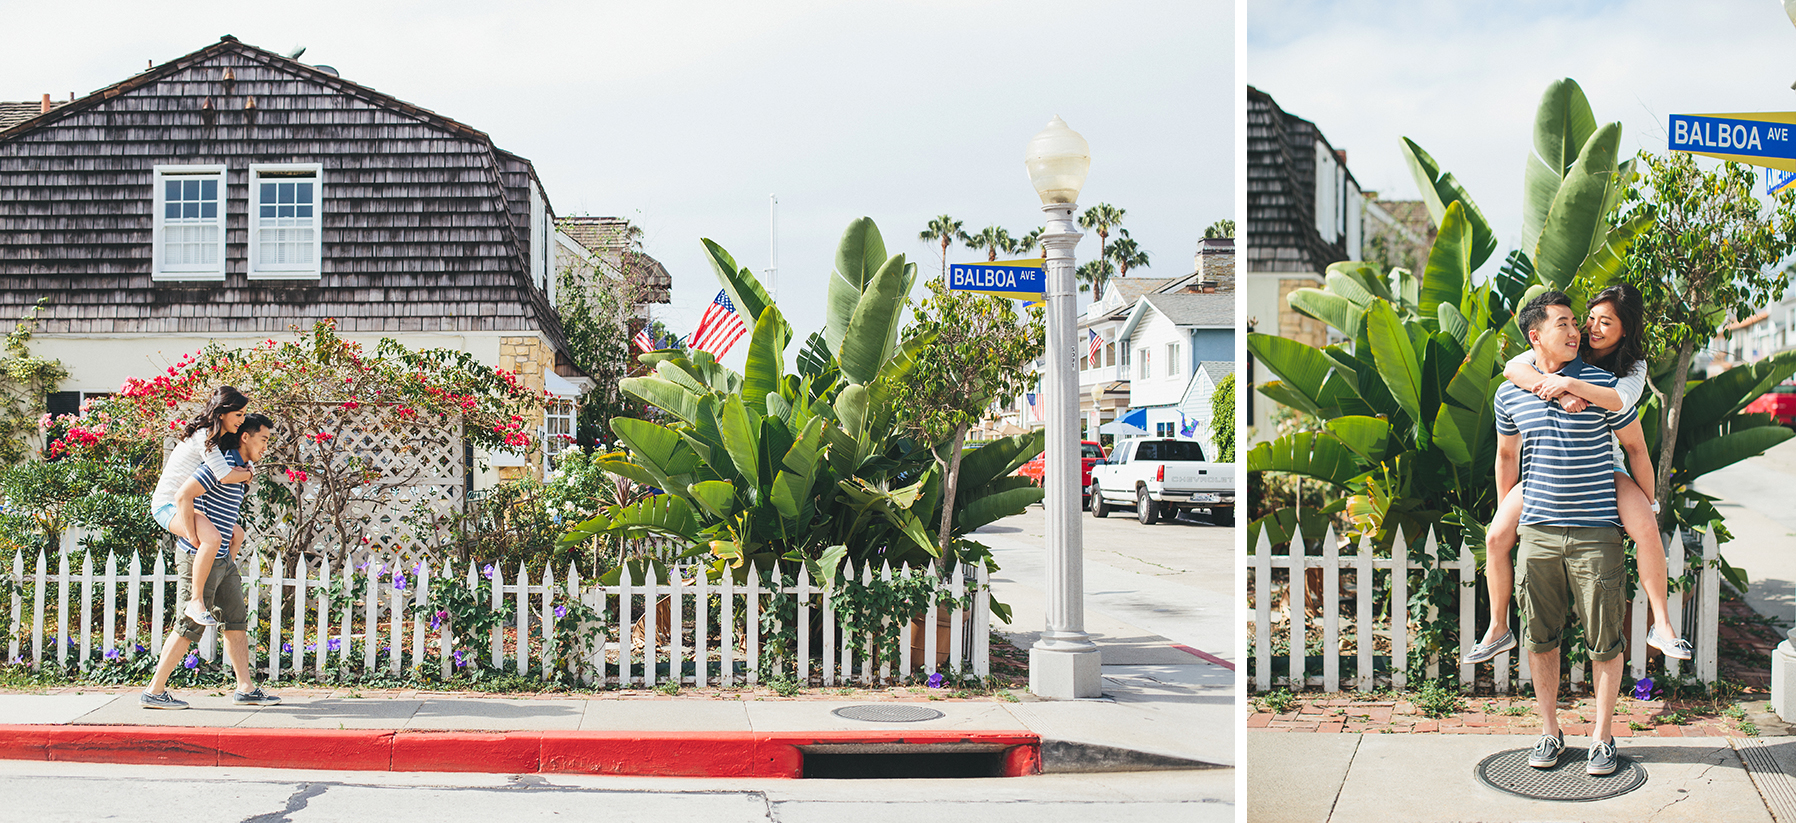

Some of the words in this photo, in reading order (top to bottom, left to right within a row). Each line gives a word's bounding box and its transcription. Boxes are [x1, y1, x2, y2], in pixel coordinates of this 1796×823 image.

[1675, 120, 1762, 151] BALBOA
[1767, 127, 1789, 142] AVE
[954, 268, 1017, 288] BALBOA
[1020, 271, 1036, 281] AVE
